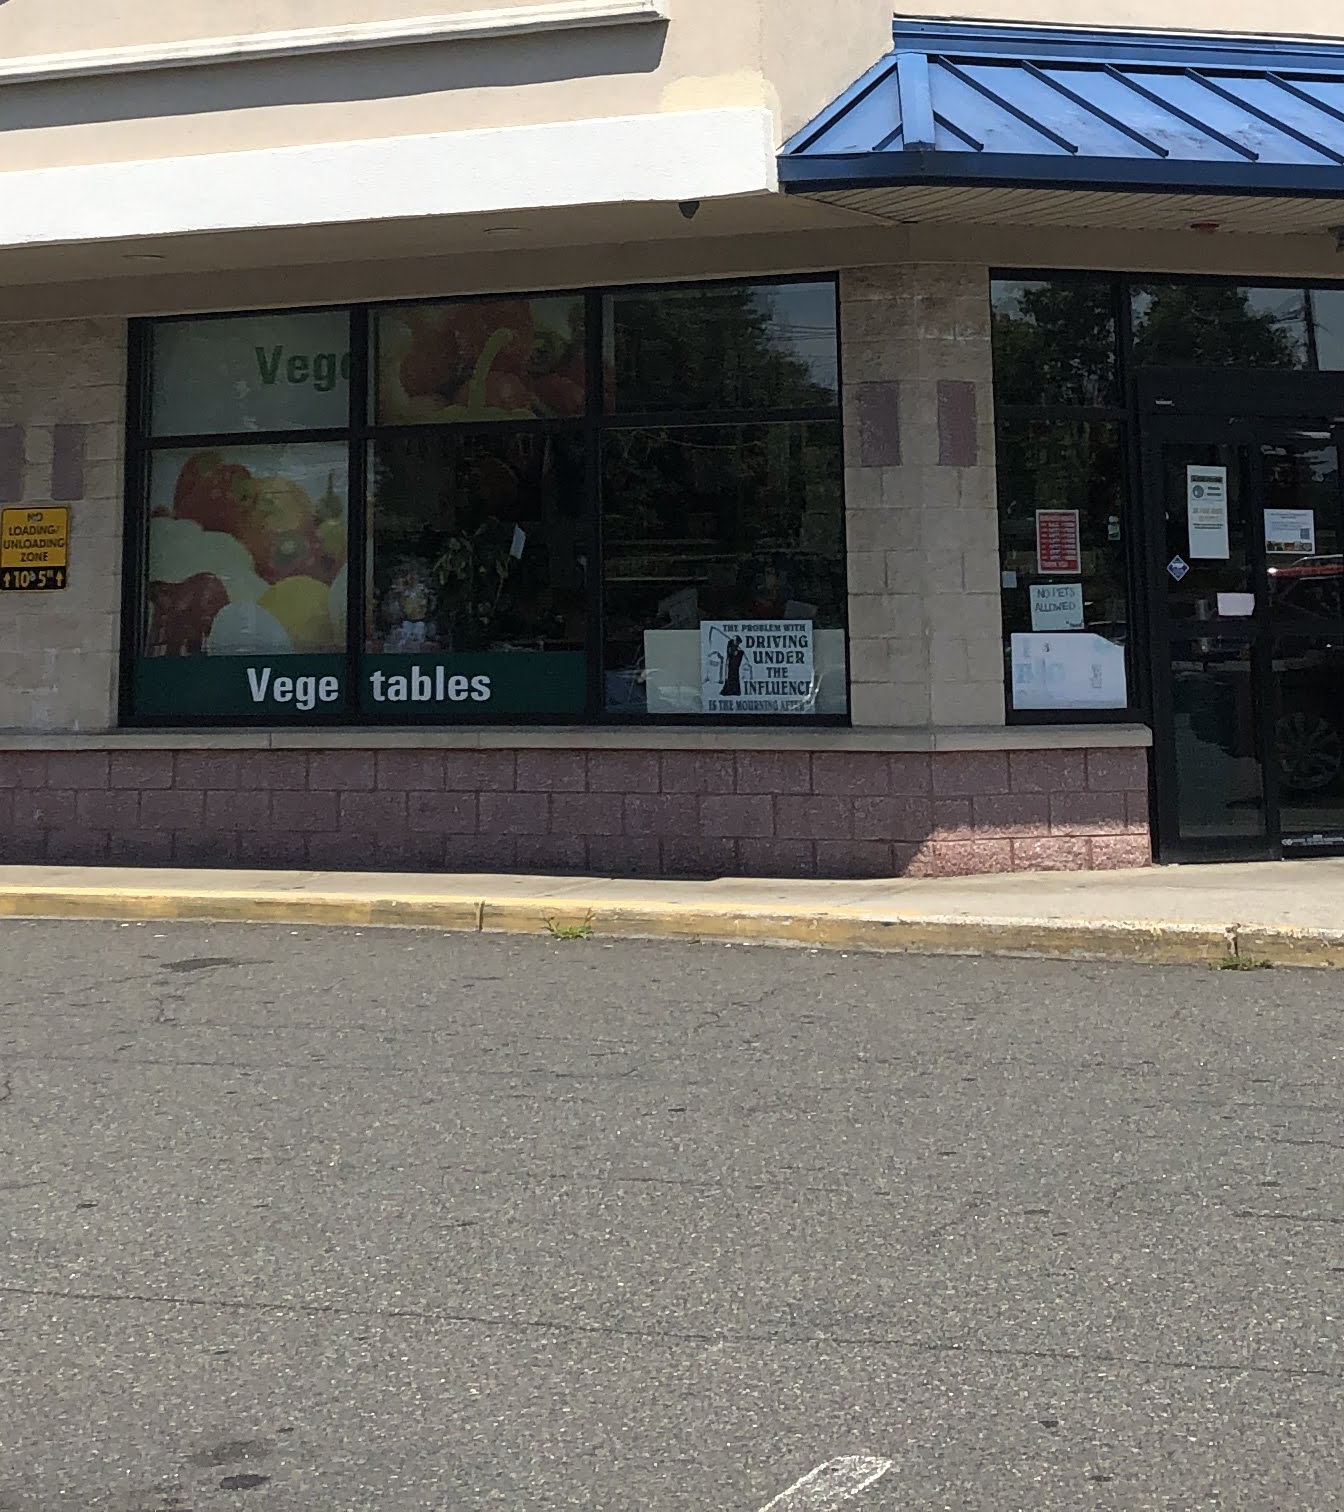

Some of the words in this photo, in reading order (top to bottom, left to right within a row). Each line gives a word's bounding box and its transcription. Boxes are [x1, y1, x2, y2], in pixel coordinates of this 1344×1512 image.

[3, 538, 65, 550] UNLOADING
[20, 551, 49, 563] ZONE
[1034, 600, 1077, 613] ALLOWED
[723, 624, 739, 633] THE
[741, 624, 781, 633] PROBLEM
[745, 635, 809, 649] DRIVING
[752, 650, 806, 665] UNDER
[766, 667, 789, 679] THE
